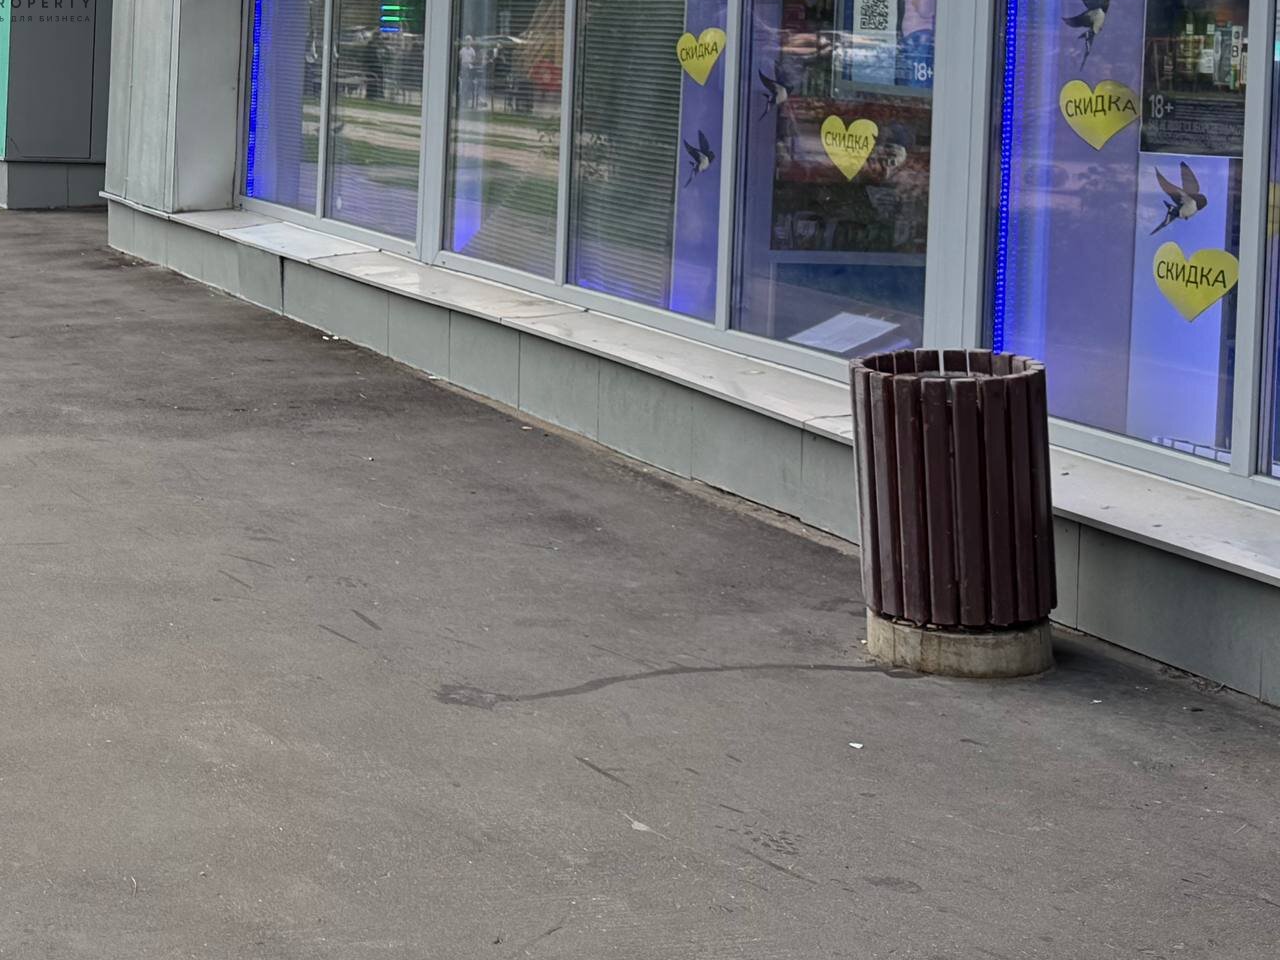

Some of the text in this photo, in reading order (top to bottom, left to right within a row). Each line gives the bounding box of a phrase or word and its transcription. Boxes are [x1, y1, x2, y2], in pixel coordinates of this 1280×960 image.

[680, 41, 719, 62] СКИДКА
[913, 62, 933, 81] 18+
[1065, 95, 1138, 119] СКИДКА
[1148, 94, 1174, 118] 18+
[824, 129, 870, 153] СКИДКА
[1156, 259, 1228, 289] СКИДКА
